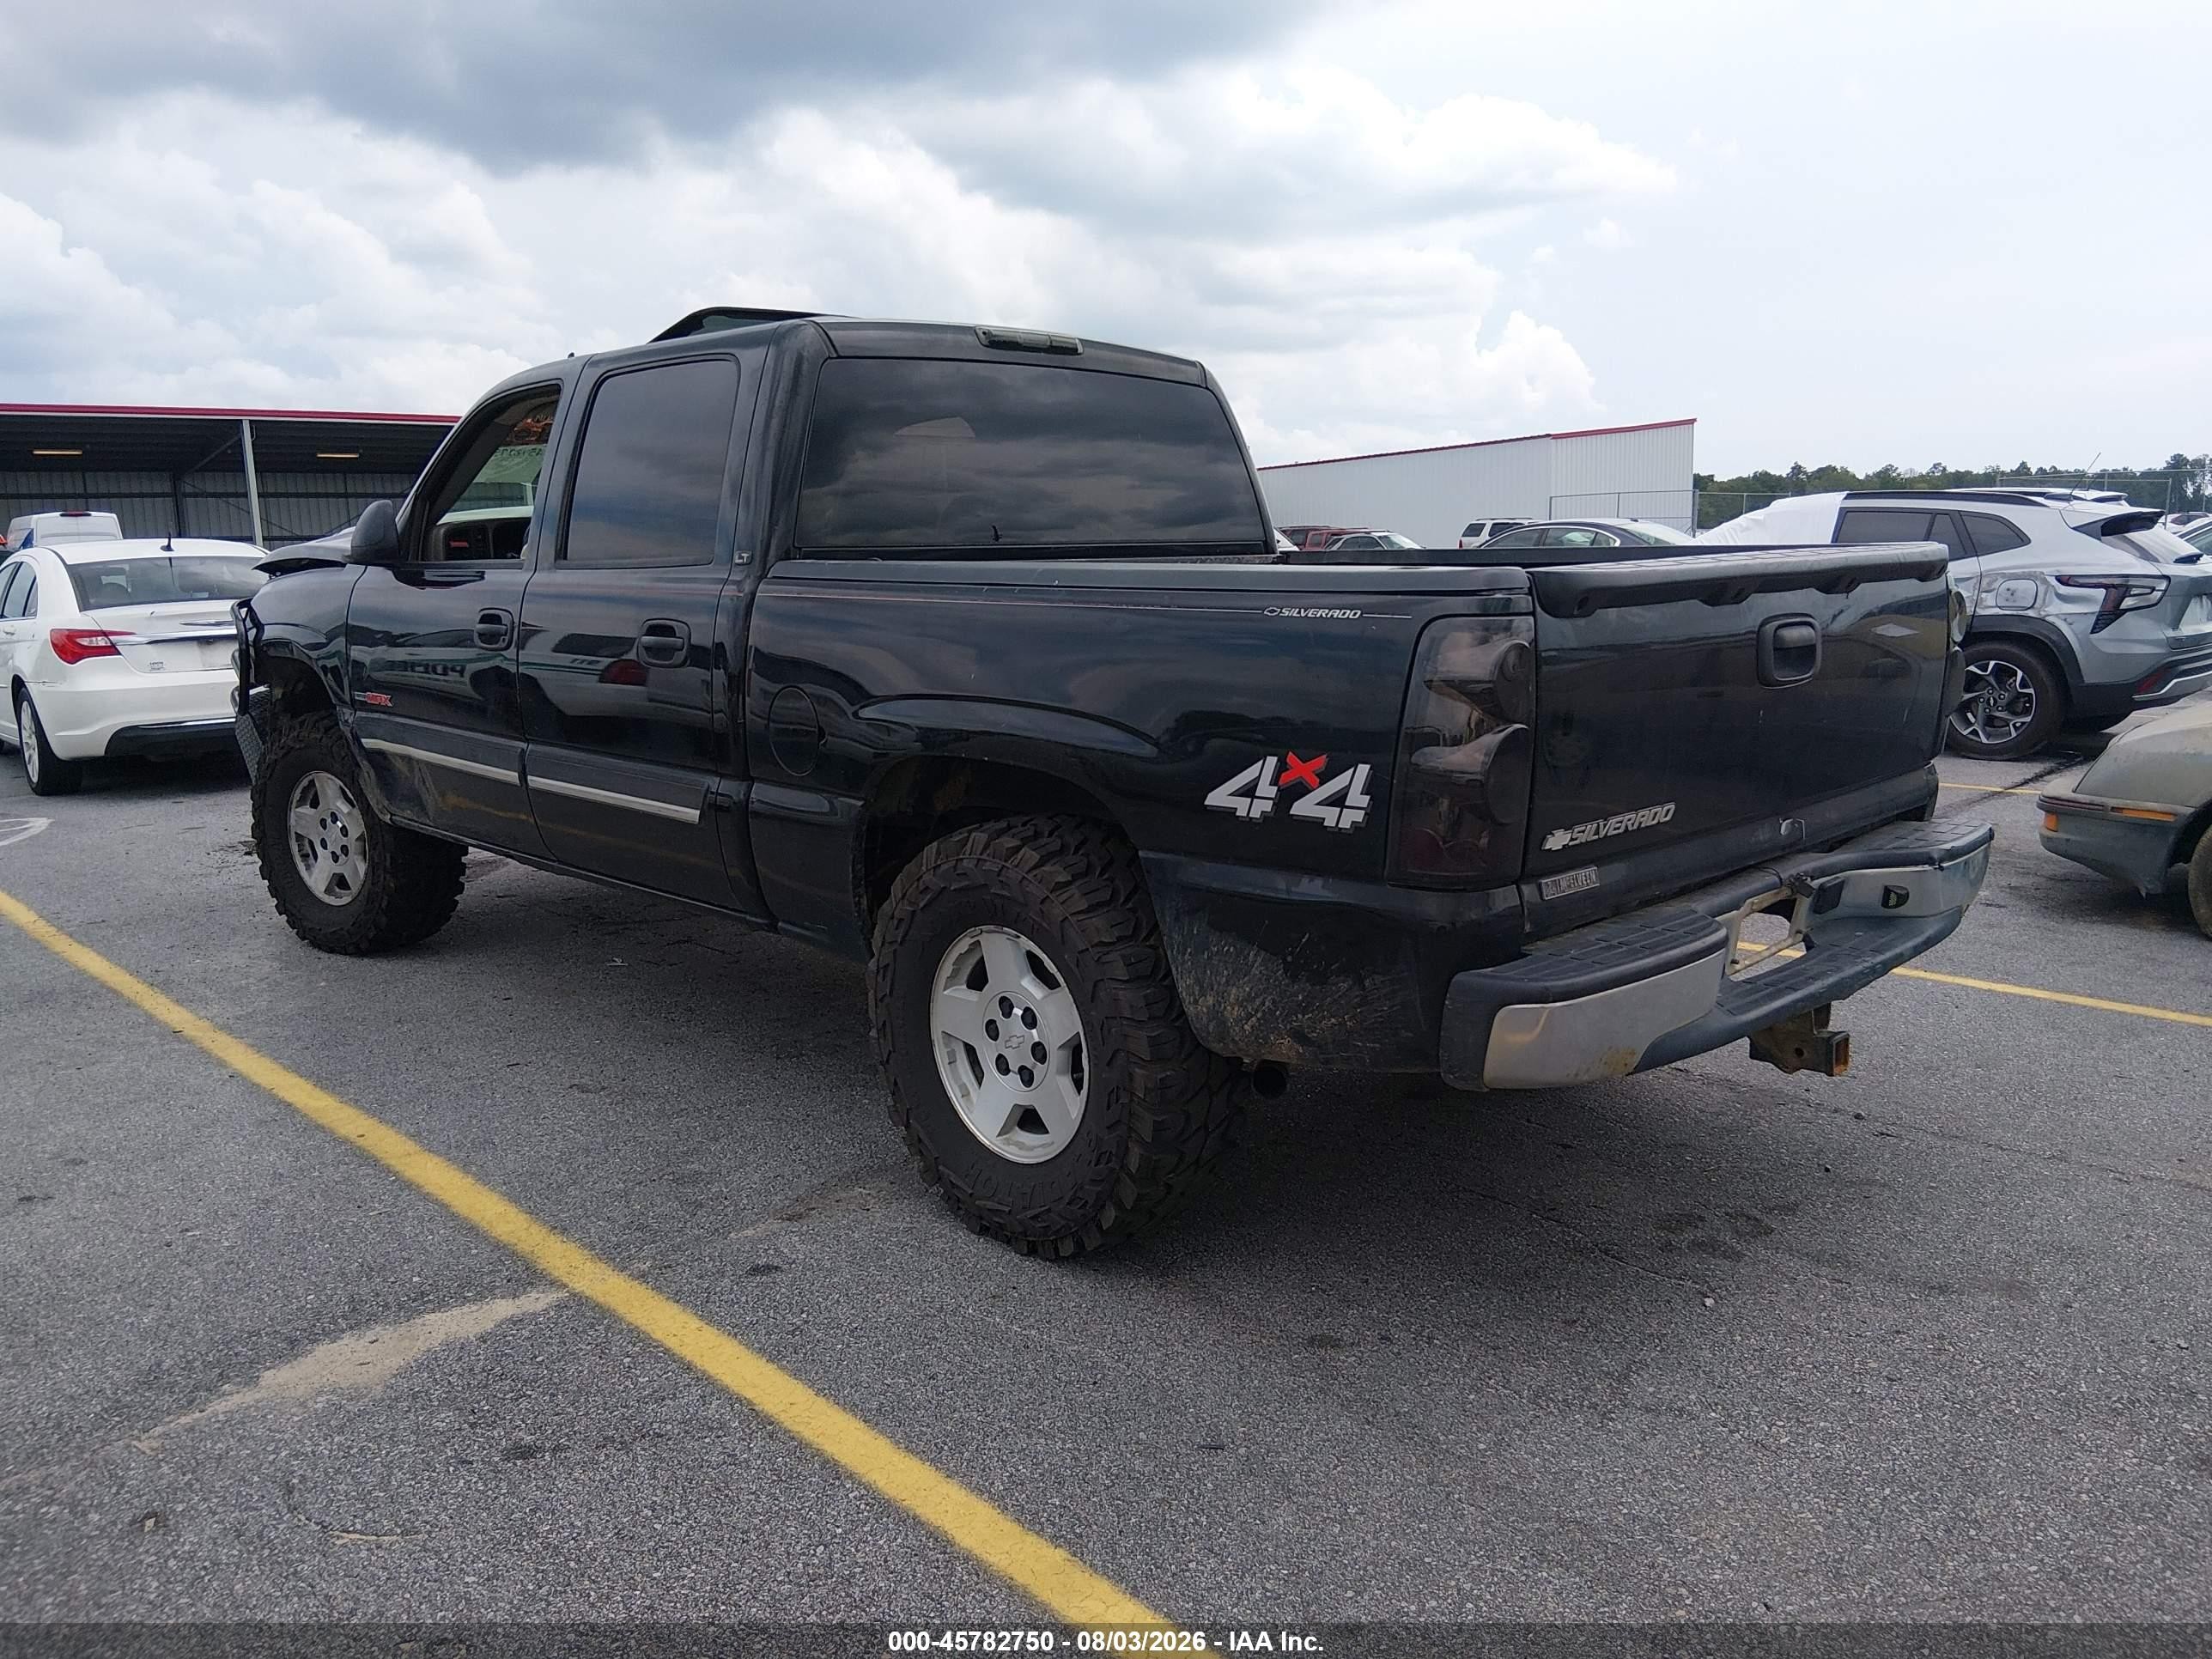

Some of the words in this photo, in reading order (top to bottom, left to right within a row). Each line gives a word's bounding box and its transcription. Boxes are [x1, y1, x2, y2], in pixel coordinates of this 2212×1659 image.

[735, 552, 750, 563] LT
[1279, 607, 1362, 619] SILVERADO
[1569, 802, 1676, 846] SILVERADO
